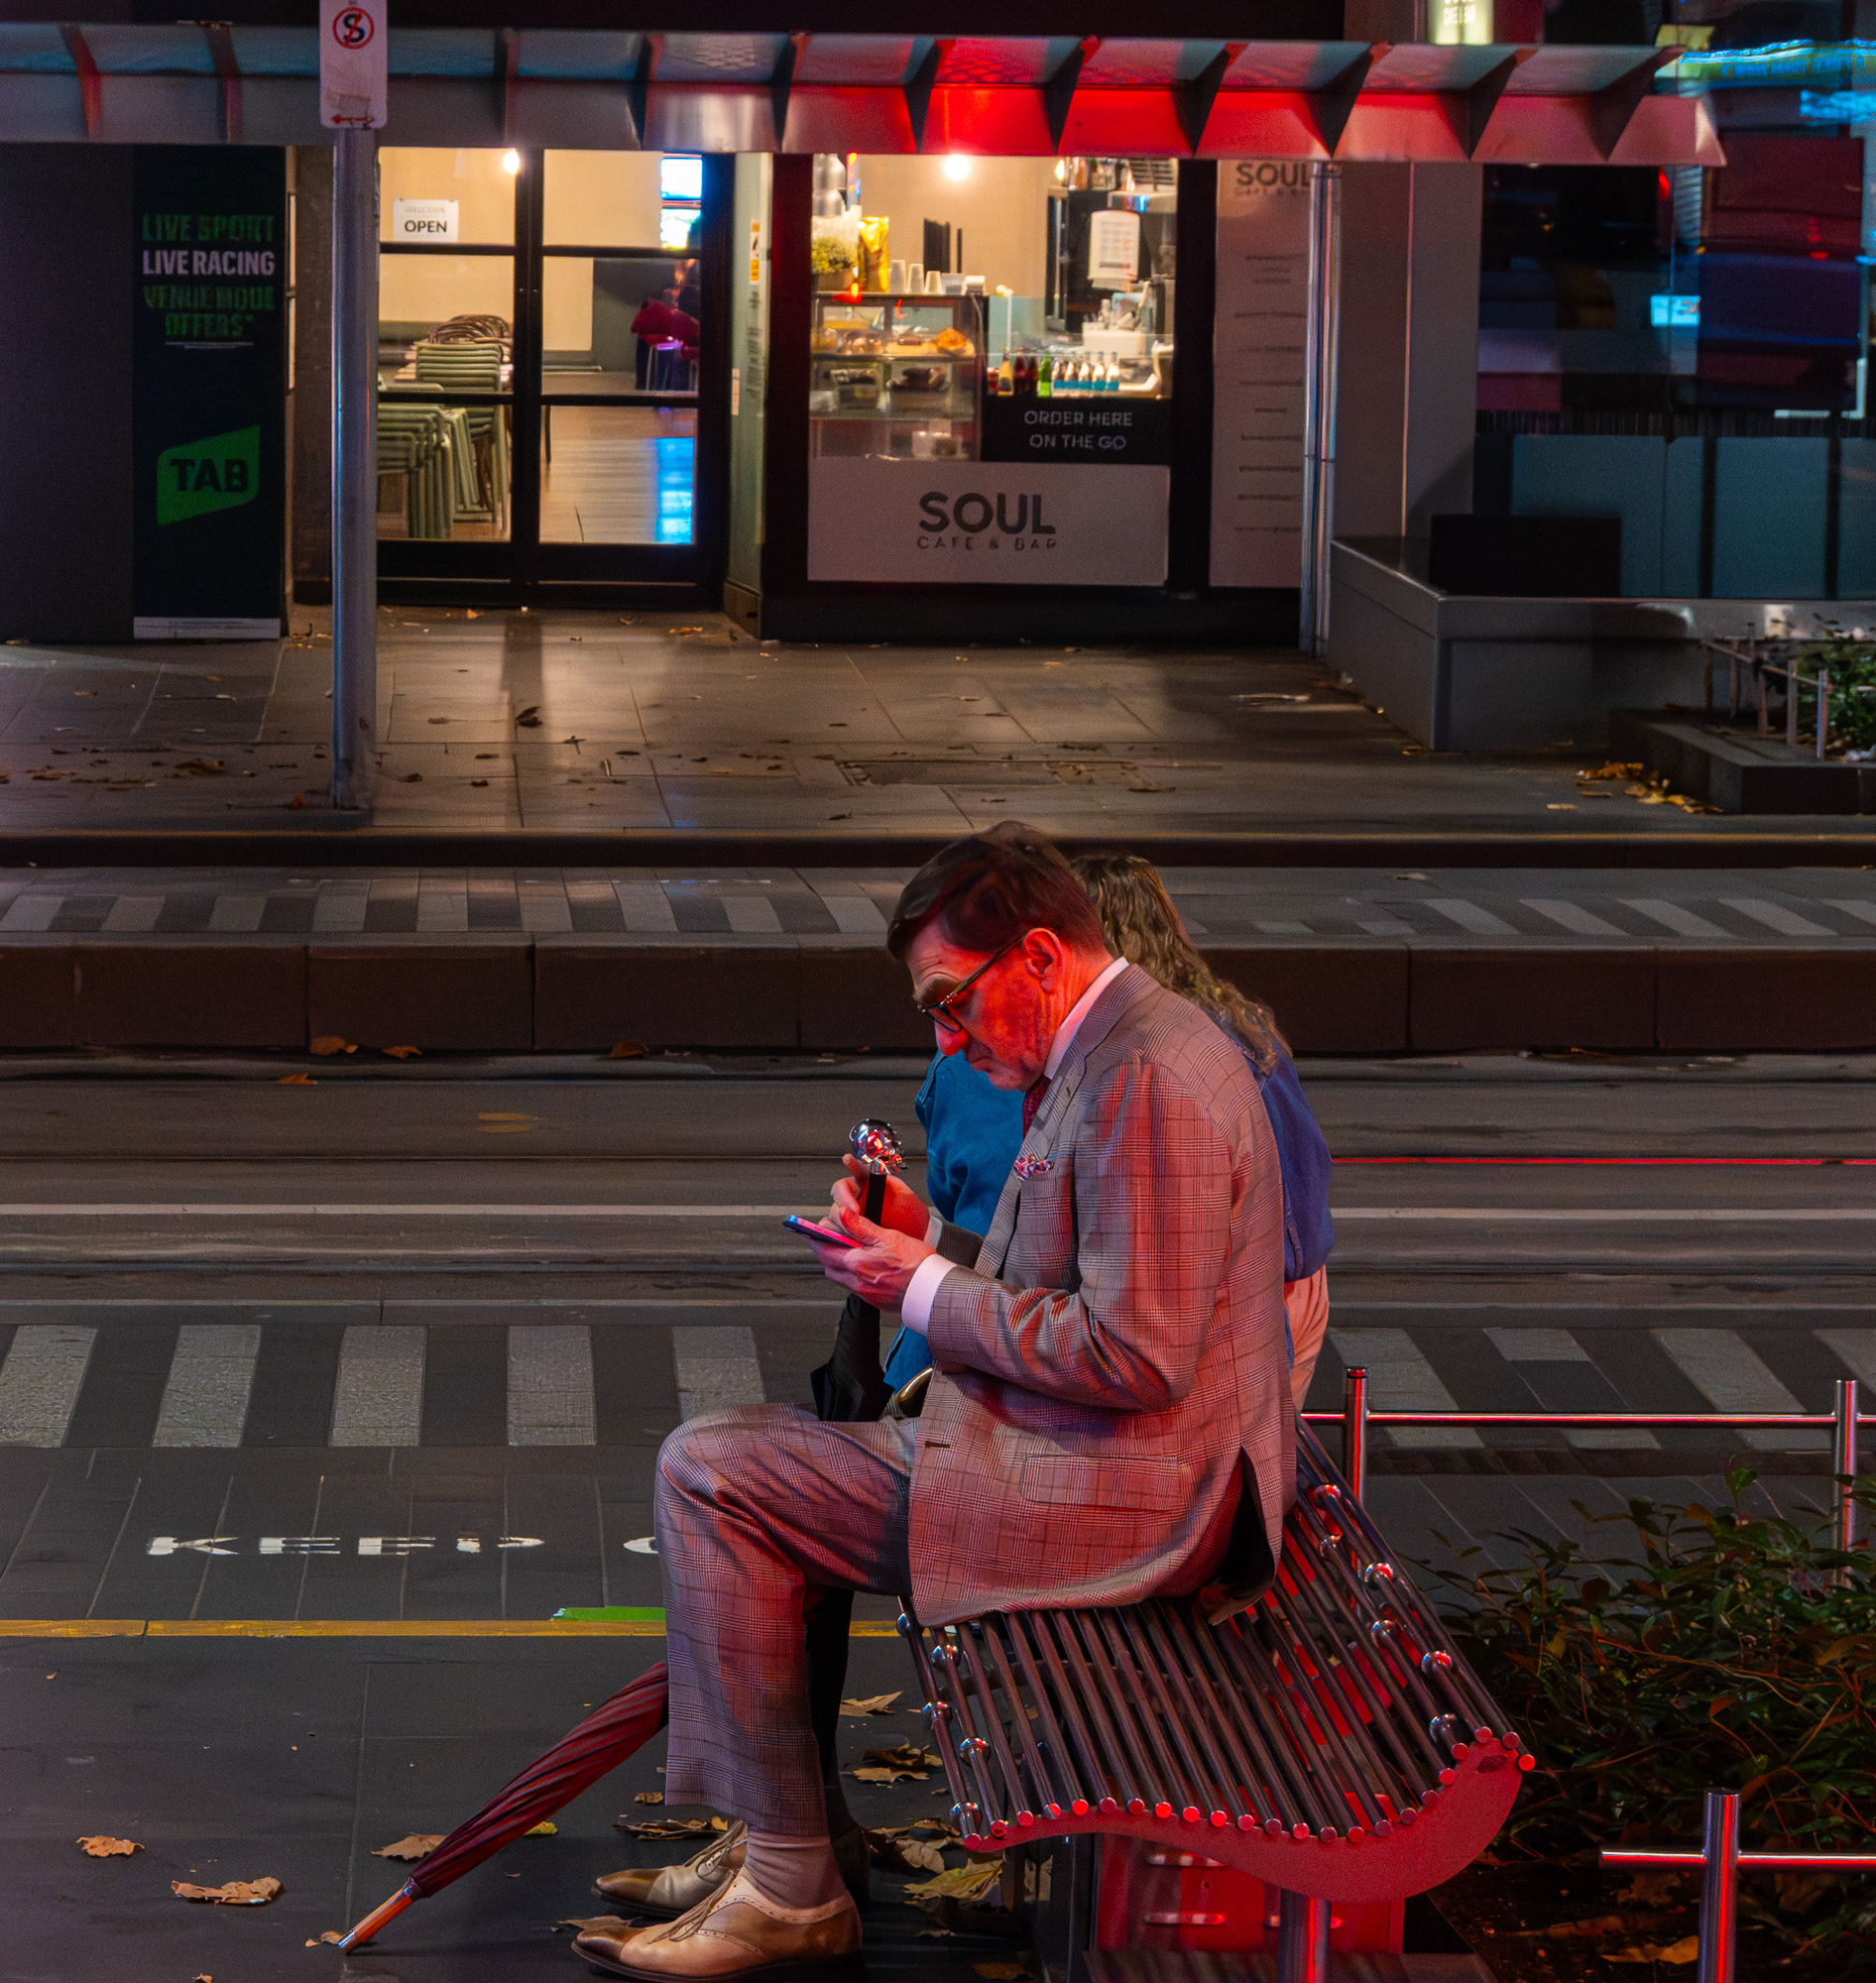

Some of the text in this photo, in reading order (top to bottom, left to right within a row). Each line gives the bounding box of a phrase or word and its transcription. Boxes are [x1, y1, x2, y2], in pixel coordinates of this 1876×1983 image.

[1235, 162, 1310, 187] SOUL
[142, 212, 192, 242] LIVE
[405, 219, 447, 233] OPEN
[142, 249, 276, 277] LIVE RACING
[1023, 409, 1133, 427] ORDER HERE
[1028, 433, 1127, 450] ON THE GO
[170, 457, 250, 494] TAB
[918, 490, 1057, 534] SOUL
[916, 535, 974, 551] CAFE
